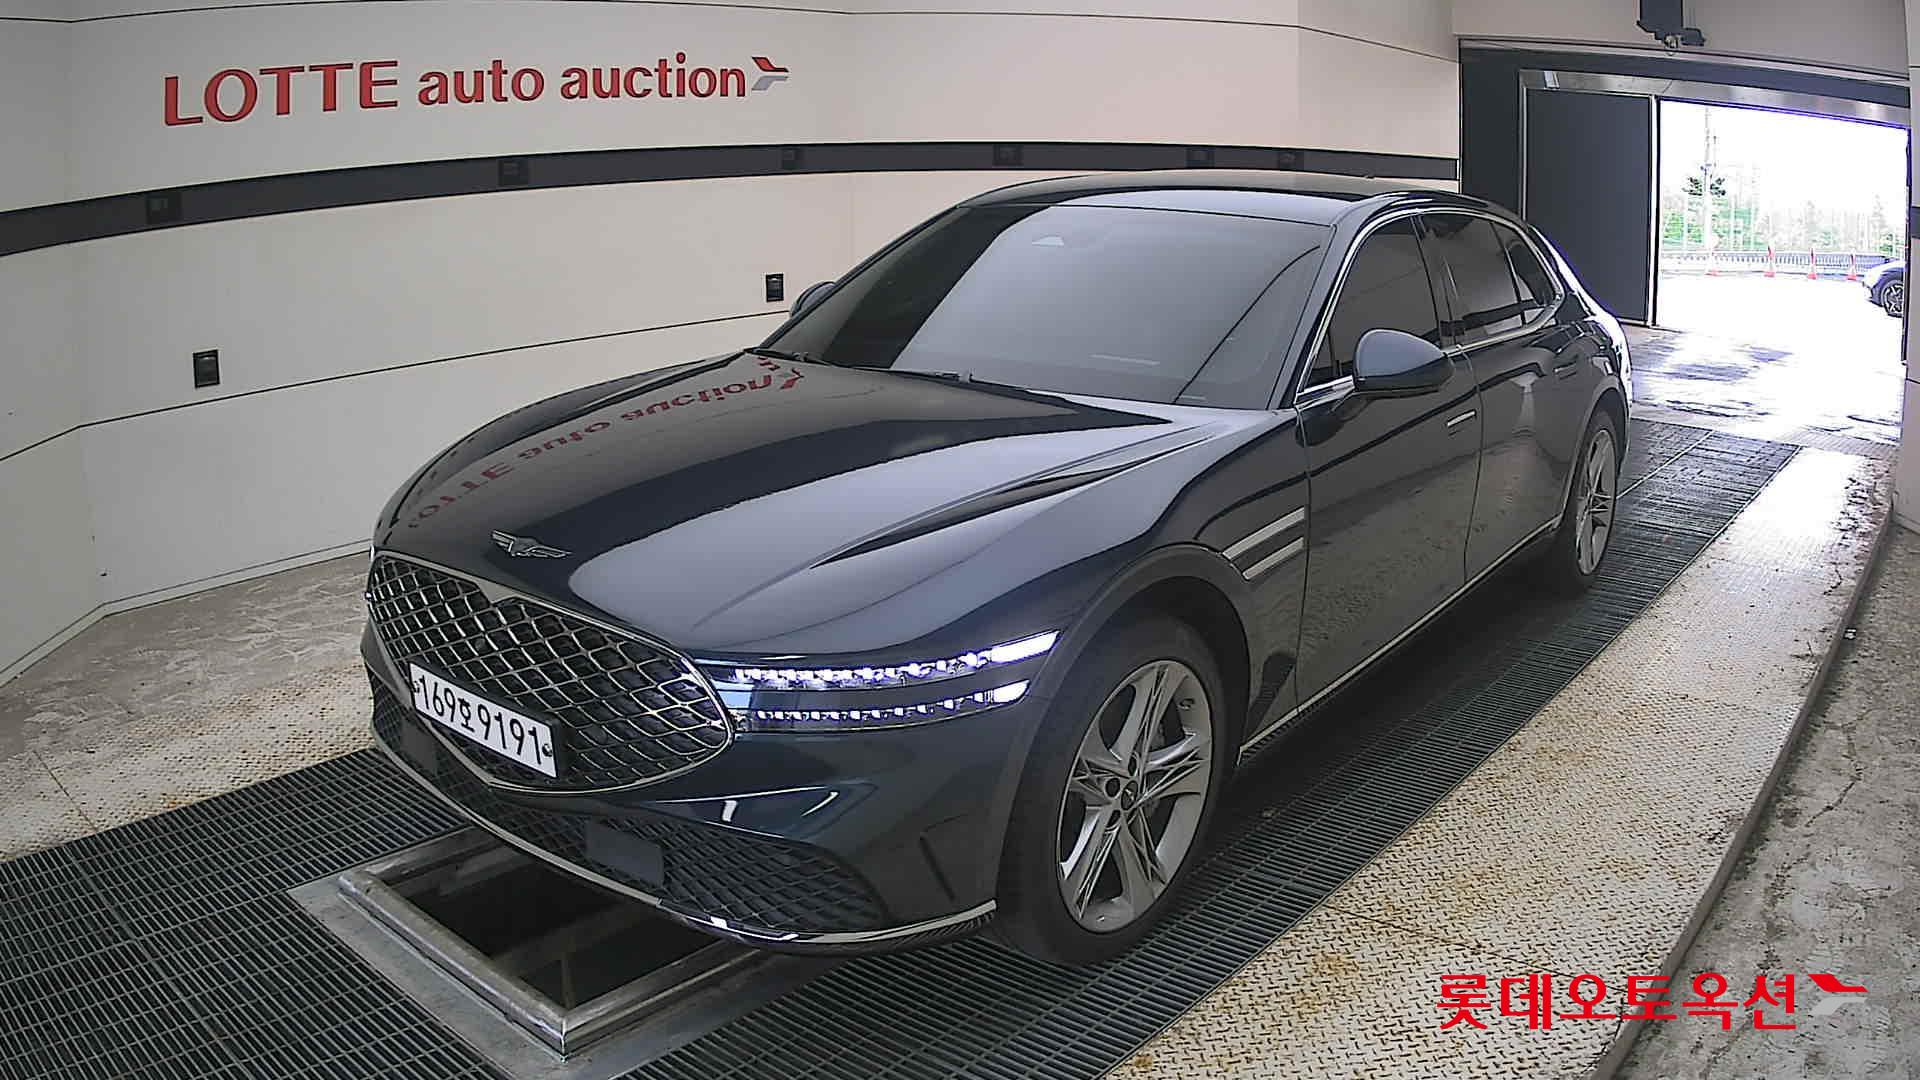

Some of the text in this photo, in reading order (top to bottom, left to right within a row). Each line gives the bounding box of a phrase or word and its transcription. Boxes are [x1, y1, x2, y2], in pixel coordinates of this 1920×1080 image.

[164, 51, 746, 126] LOTTE auto auction
[418, 675, 541, 765] 169호9191
